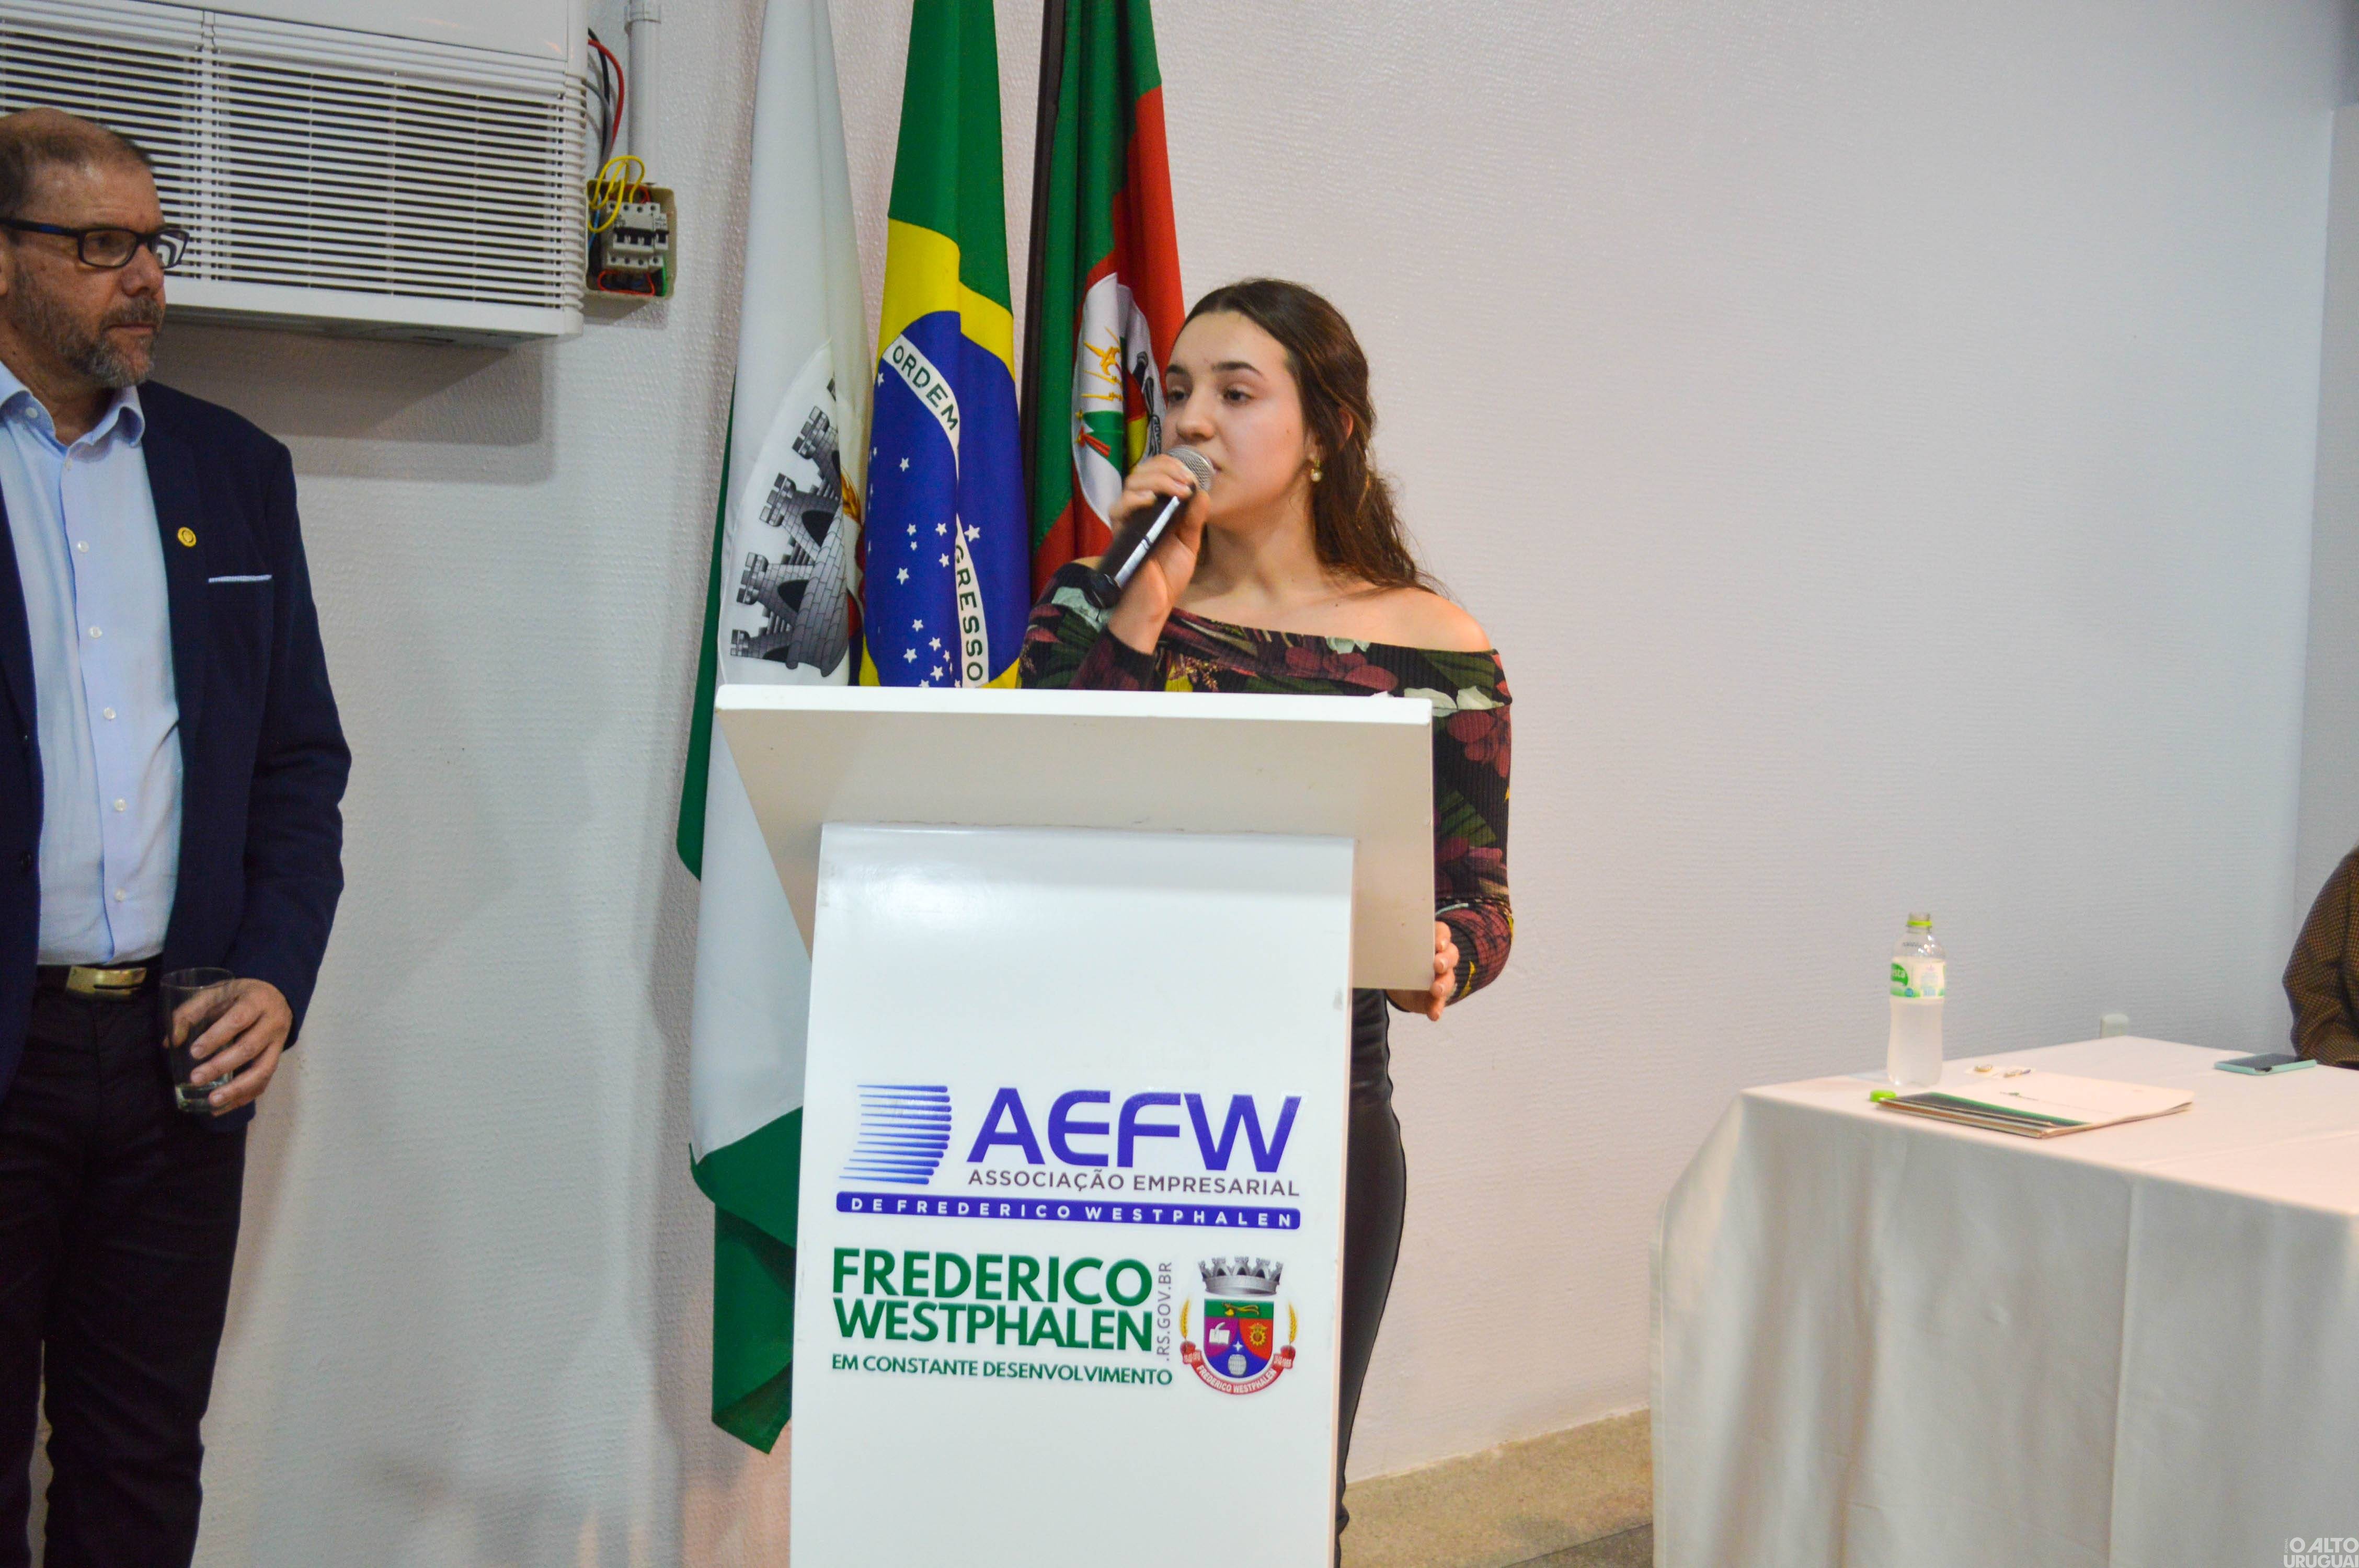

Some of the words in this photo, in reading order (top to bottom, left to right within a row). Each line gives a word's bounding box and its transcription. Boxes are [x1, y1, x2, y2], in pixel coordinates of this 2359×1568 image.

[892, 345, 958, 431] ORDEM
[955, 545, 983, 681] GRESSO
[966, 1087, 1302, 1173] AEFW
[968, 1169, 1125, 1192] ASSOCIAÇÃO
[1133, 1175, 1300, 1197] EMPRESARIAL
[851, 1197, 883, 1212] DE
[897, 1200, 1070, 1218] FREDERICO
[1085, 1206, 1291, 1227] WESTPHALEN
[833, 1248, 1152, 1307] FREDERICO
[833, 1297, 1152, 1352] WESTPHALEN
[1156, 1262, 1172, 1362] .RS.GOV.BR
[832, 1353, 858, 1371] EM
[863, 1355, 978, 1376] CONSTANTE
[983, 1363, 1173, 1386] DESENVOLVIMENTO
[1196, 1365, 1232, 1393] FREDERICO
[1233, 1368, 1277, 1393] WESTPHALEN
